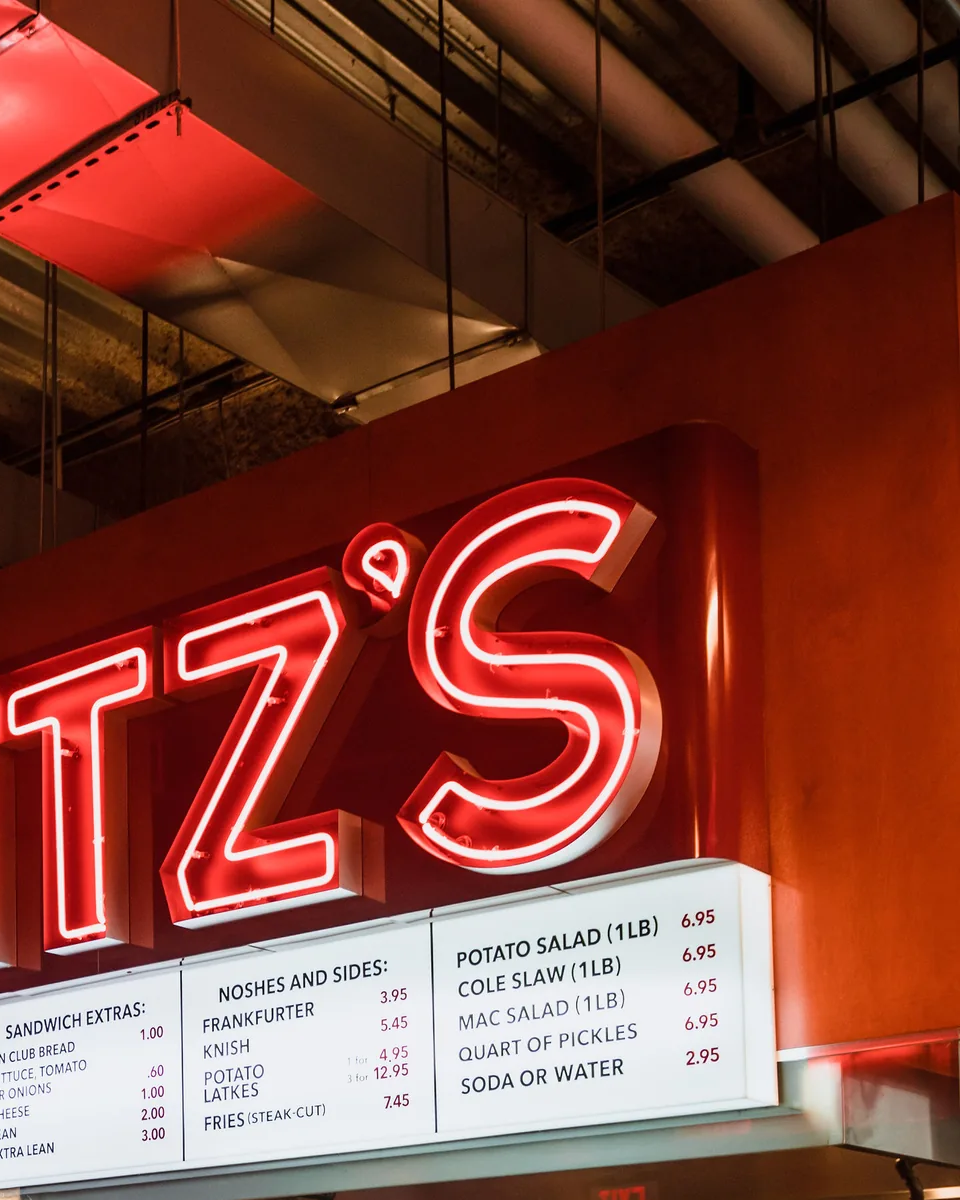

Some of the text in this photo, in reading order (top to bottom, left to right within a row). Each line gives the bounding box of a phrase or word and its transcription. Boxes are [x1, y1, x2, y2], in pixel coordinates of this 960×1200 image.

[681, 909, 715, 928] 6.95
[457, 915, 659, 968] POTATO SALAD (1LB)
[682, 943, 716, 962] 6.95
[219, 959, 388, 1003] NOSHES AND SIDES:
[458, 956, 621, 998] COLE SLAW (1LB)
[380, 988, 407, 1004] 3.95
[683, 978, 717, 996] 6.95
[203, 1002, 314, 1033] FRANKFURTER
[459, 989, 626, 1031] MAC SALAD (1LB)
[6, 1001, 146, 1039] SANDWICH EXTRAS:
[380, 1016, 408, 1032] 5.45
[684, 1013, 718, 1031] 6.95
[140, 1026, 164, 1040] 1.00
[459, 1023, 638, 1062] QUART OF PICKLES
[10, 1048, 35, 1063] CLUB
[39, 1042, 75, 1057] BREAD
[203, 1039, 250, 1059] KNISH
[379, 1046, 408, 1062] 4.95
[686, 1047, 719, 1066] 2.95
[40, 1059, 87, 1076] TOMATO
[147, 1065, 164, 1078] .60
[204, 1064, 264, 1085] POTATO
[373, 1063, 409, 1080] 12.95
[461, 1059, 624, 1094] SODA OR WATER
[9, 1082, 51, 1099] ONIONS
[142, 1086, 164, 1099] 1.00
[204, 1083, 259, 1103] LATKES
[384, 1094, 410, 1109] 7.45
[142, 1107, 165, 1121] 2.00
[204, 1104, 326, 1131] FRIES (STEAK-CUT)
[142, 1127, 165, 1142] 3.00
[27, 1142, 55, 1156] LEAN
